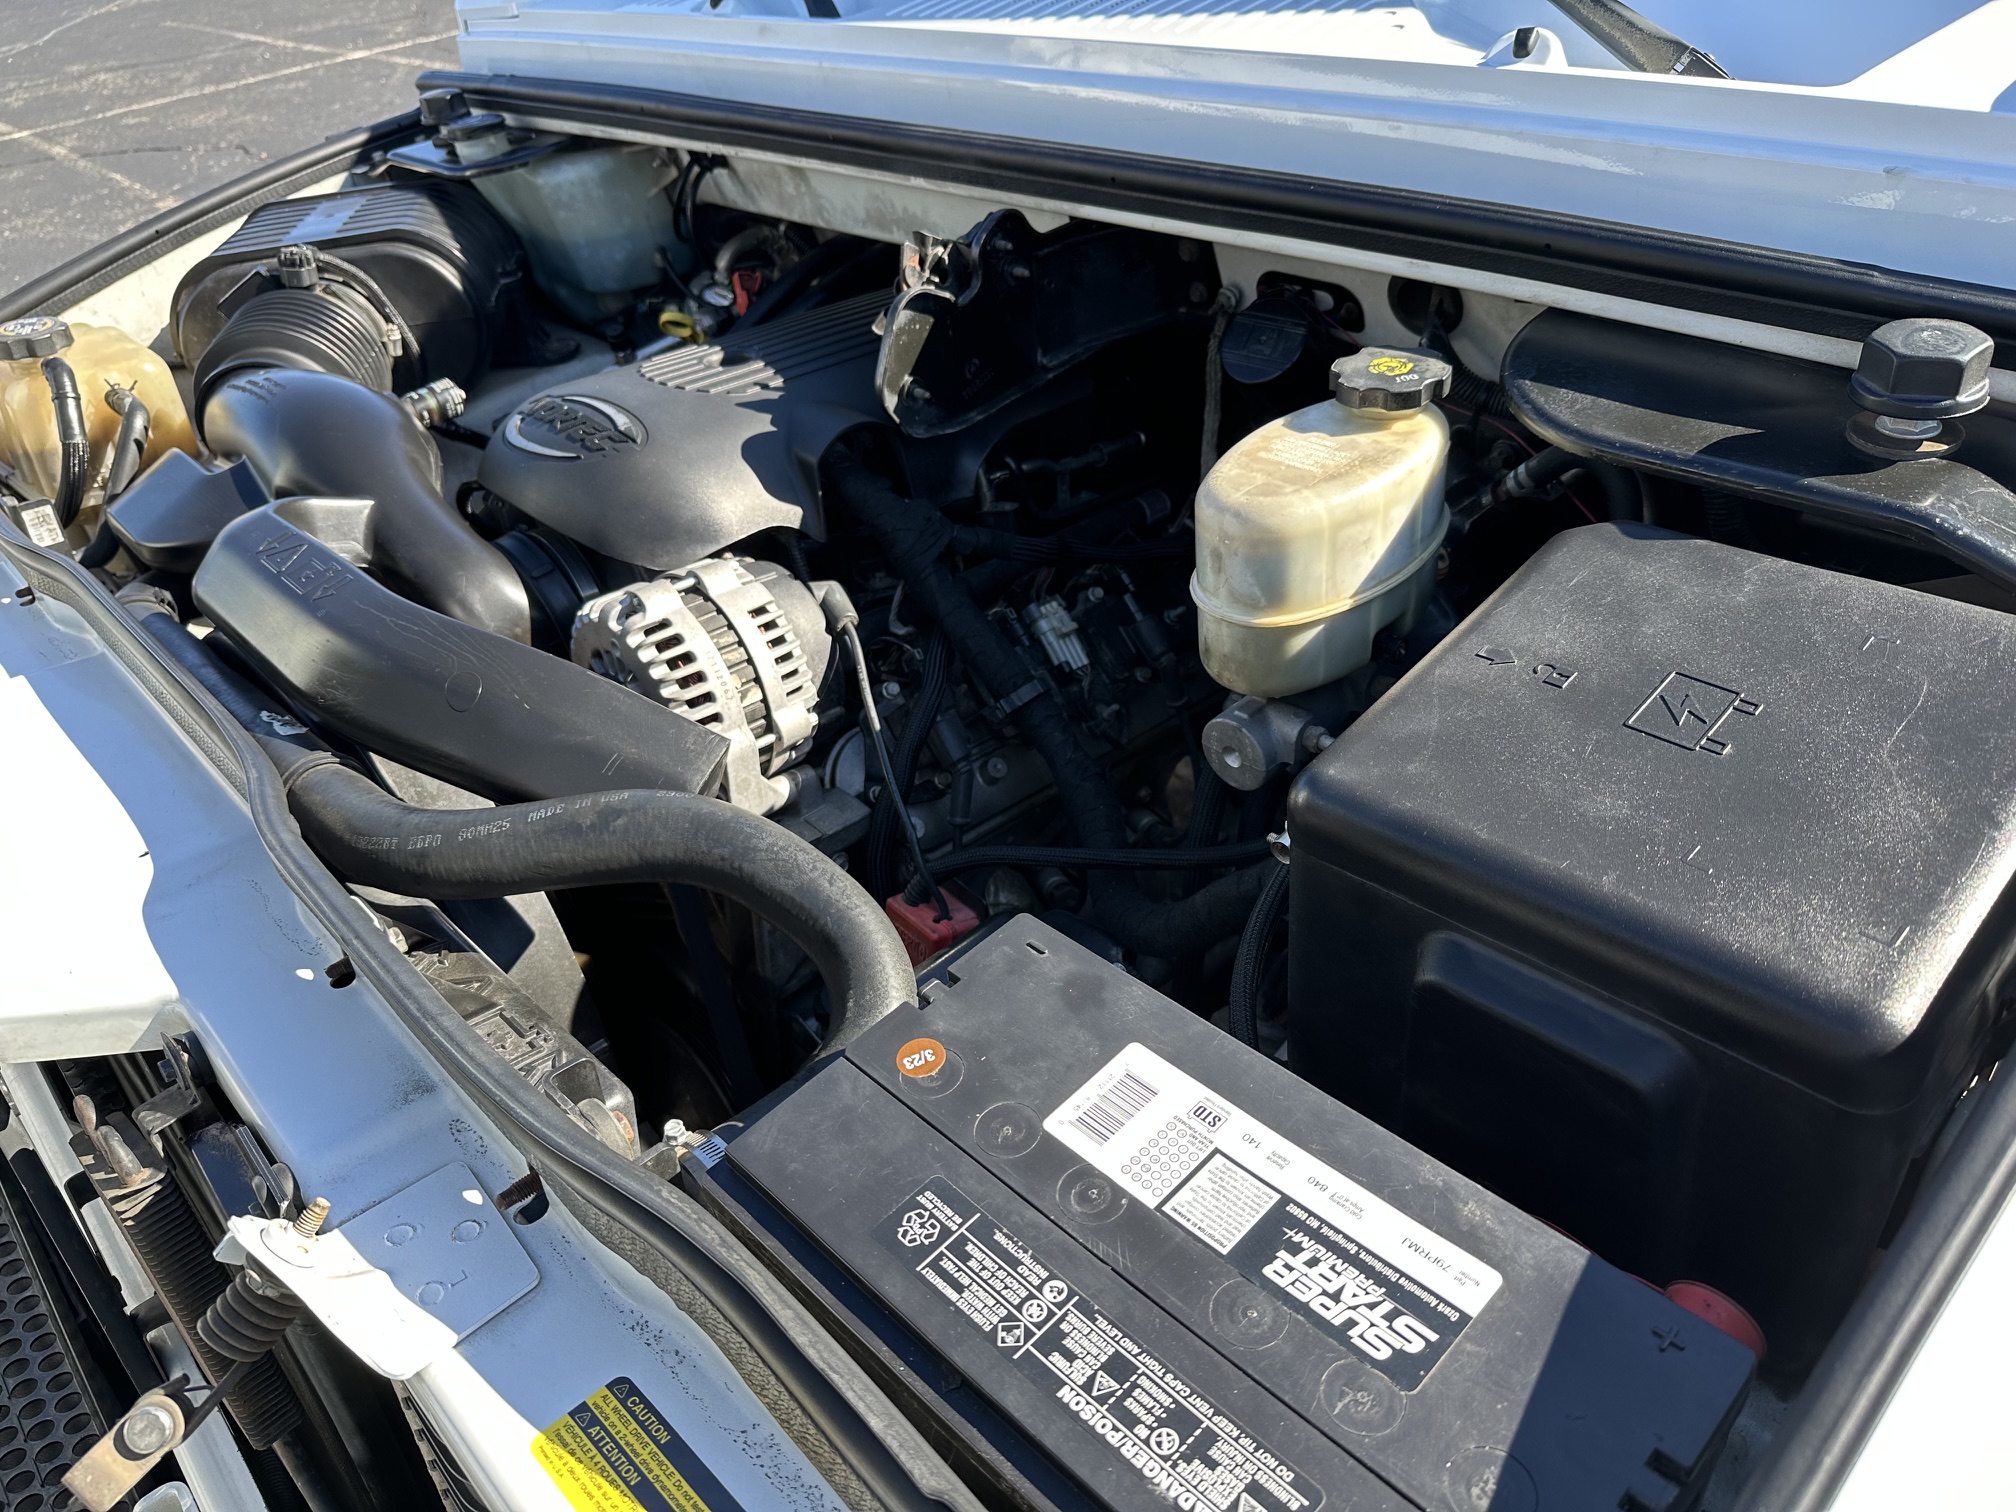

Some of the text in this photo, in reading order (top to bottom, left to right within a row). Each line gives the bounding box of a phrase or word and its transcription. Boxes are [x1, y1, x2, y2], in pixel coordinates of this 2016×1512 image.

[528, 803, 564, 822] MADE
[574, 797, 592, 809] IN
[902, 1048, 936, 1070] 3/23
[1172, 1114, 1214, 1144] MONTH PURCHASED
[1191, 1104, 1222, 1128] STD
[1186, 1138, 1206, 1153] LIFT OUT
[1188, 1132, 1210, 1148] YEAR AND
[1240, 1132, 1262, 1149] 140
[1265, 1155, 1285, 1169] Reserve
[1270, 1149, 1291, 1165] Capacity
[1306, 1175, 1329, 1192] 840
[916, 1193, 958, 1231] BATTERY MUST
[923, 1189, 962, 1224] BE RECYCLED
[1169, 1205, 1192, 1222] WARNING
[1327, 1194, 1351, 1212] Cranking
[910, 1221, 924, 1234] Pb
[1196, 1225, 1227, 1248] PROPOSITION
[1285, 1201, 1460, 1322] Ozark Automotive Distributors, Springfield, MO 65802
[1400, 1236, 1452, 1273] 79PRMJ
[952, 1268, 972, 1287] HELP
[966, 1256, 1021, 1305] KEEP OUT OF THE
[994, 1267, 1007, 1280] OF
[1002, 1274, 1029, 1298] REACH
[1016, 1262, 1041, 1286] READ
[1453, 1275, 1466, 1286] Part
[920, 1265, 994, 1332] FLUSH EYES IMMEDIATELY
[967, 1281, 996, 1307] MEDICAL
[1275, 1248, 1439, 1356] START
[979, 1305, 1001, 1324] WITH
[990, 1301, 1008, 1318] GET
[1261, 1259, 1394, 1361] SUPER
[1058, 1319, 1108, 1363] BLINDNESS OR
[1061, 1334, 1102, 1370] CAN CAUSE
[1086, 1329, 1116, 1356] SEVERE
[1117, 1334, 1141, 1356] AND
[1046, 1349, 1088, 1386] SULFURIC
[1070, 1356, 1095, 1378] ACID
[1136, 1349, 1167, 1378] TIGHT
[1135, 1374, 1173, 1407] SMOKING
[1162, 1371, 1192, 1398] CAPS
[1122, 1395, 1156, 1426] SPARKS
[1130, 1386, 1164, 1416] FLAMES
[1186, 1391, 1216, 1418] VENT
[625, 1394, 671, 1444] CAUTION
[1131, 1422, 1151, 1440] NO
[1210, 1411, 1241, 1439] KEEP
[590, 1398, 612, 1422] vehicle
[607, 1420, 618, 1430] on
[618, 1433, 642, 1459] 2-wheel
[638, 1457, 656, 1474] drive
[599, 1392, 695, 1503] ALL WHEEL DRIVE VEHICLE: Do not
[1054, 1382, 1199, 1511] DANGER/POISON
[561, 1420, 621, 1492] VÉHICULE À 4 ROUES
[586, 1423, 642, 1486] ATTENTION
[1205, 1444, 1253, 1485] CAN CAUSE
[1252, 1446, 1279, 1470] NOT
[552, 1427, 571, 1448] l'essai
[567, 1446, 578, 1457] de
[574, 1455, 583, 1465] ce
[600, 1490, 612, 1501] sur
[609, 1501, 620, 1511] un
[566, 1465, 582, 1482] deux
[578, 1481, 595, 1500] roues
[1187, 1457, 1239, 1502] EXPLOSIVE
[1212, 1463, 1246, 1494] GASES
[1273, 1463, 1295, 1483] DO
[1195, 1479, 1232, 1511] SHIELD
[1240, 1458, 1302, 1512] BLINDNESS OR
